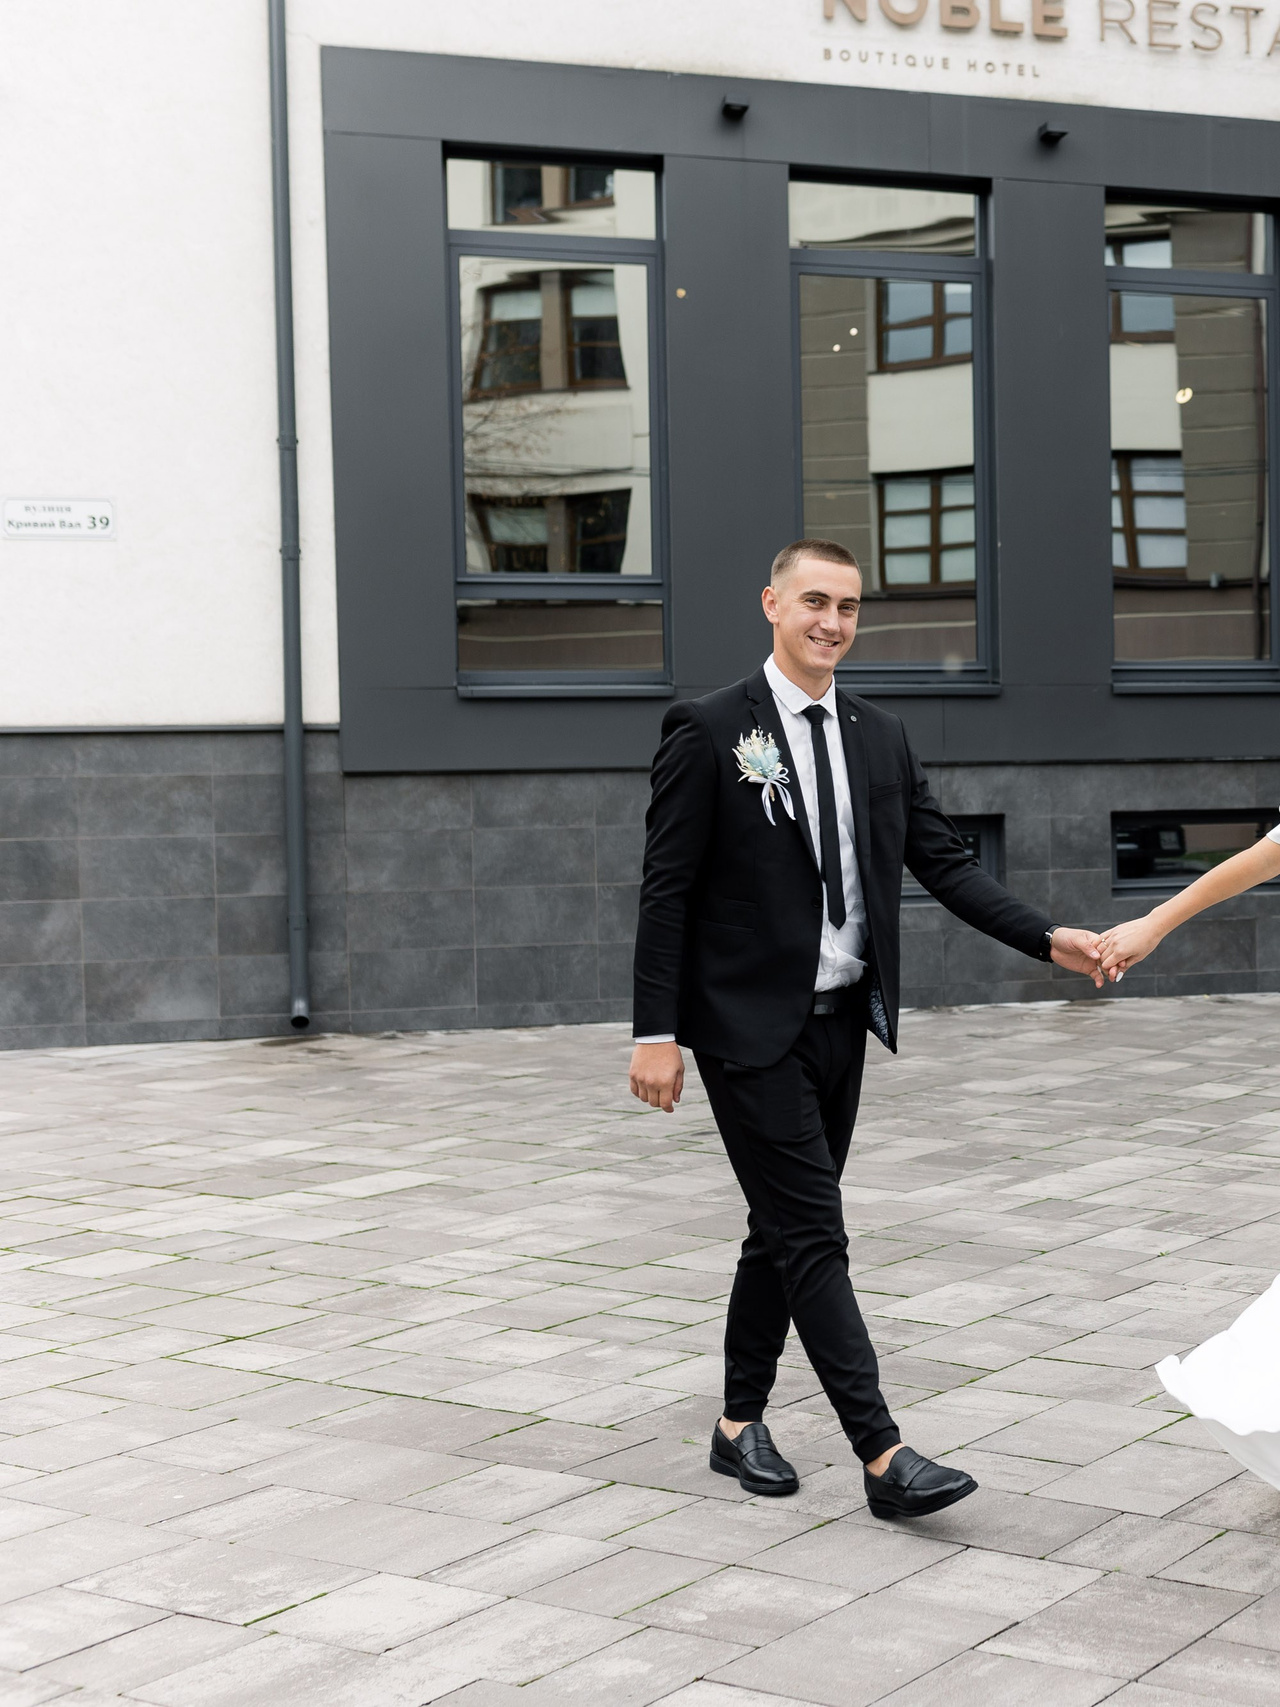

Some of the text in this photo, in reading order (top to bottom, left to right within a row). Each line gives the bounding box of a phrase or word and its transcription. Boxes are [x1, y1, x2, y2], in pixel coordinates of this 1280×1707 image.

[823, 48, 1040, 78] BOUTIQUE HOTEL
[87, 515, 110, 530] 39
